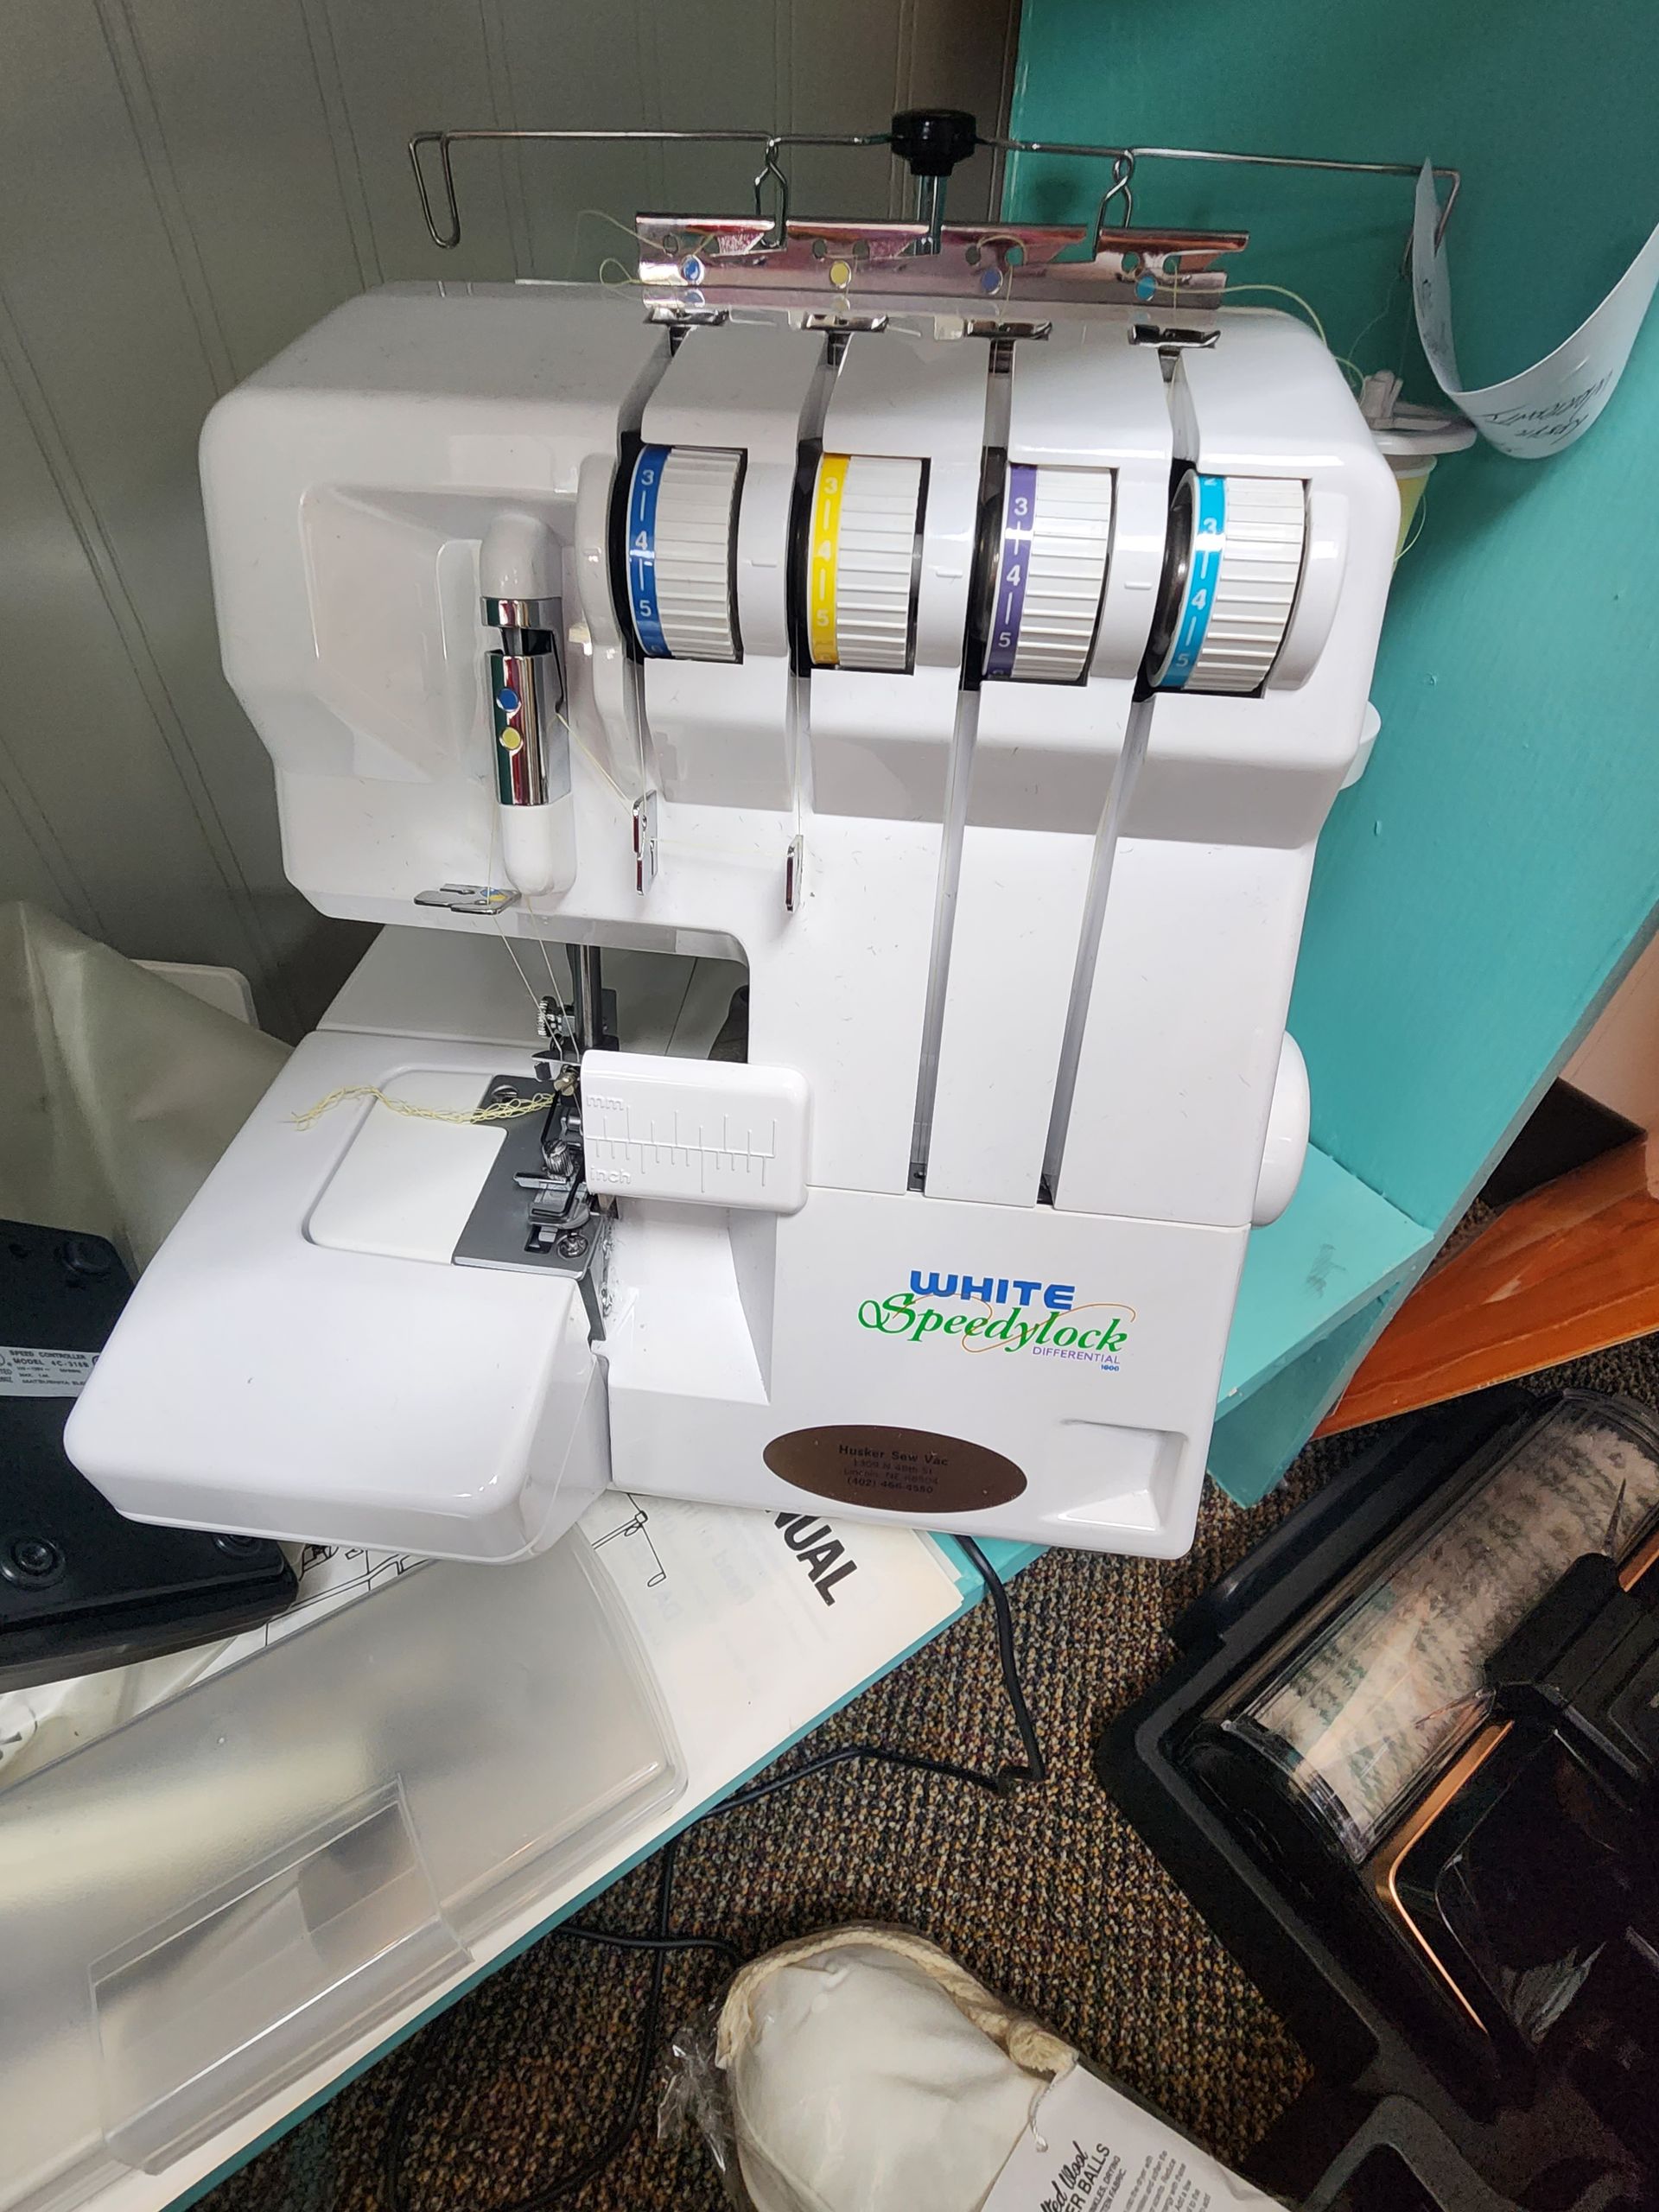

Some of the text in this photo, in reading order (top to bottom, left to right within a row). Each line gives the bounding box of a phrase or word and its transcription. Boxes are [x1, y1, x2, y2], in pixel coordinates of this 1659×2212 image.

[641, 469, 654, 485] 3
[824, 477, 838, 495] 3
[1014, 497, 1028, 516] 3
[1203, 517, 1217, 535] 3
[635, 531, 647, 550] 4
[817, 539, 831, 562] 4
[1006, 564, 1020, 587] 4
[639, 600, 652, 617] 5
[1192, 588, 1207, 611] 4
[817, 608, 830, 627] 5
[997, 632, 1012, 647] 5
[1175, 652, 1190, 668] 5
[586, 1095, 624, 1111] mm
[590, 1166, 632, 1185] inch
[910, 1270, 1076, 1310] WHITE
[858, 1293, 1128, 1352] Speedylock
[1033, 1346, 1120, 1364] DIFFERENTIAL
[839, 1445, 949, 1466] Husker Sew Vac
[774, 1512, 858, 1607] UAL
[1058, 2140, 1089, 2190] Wool
[1077, 2143, 1110, 2195] BALLS
